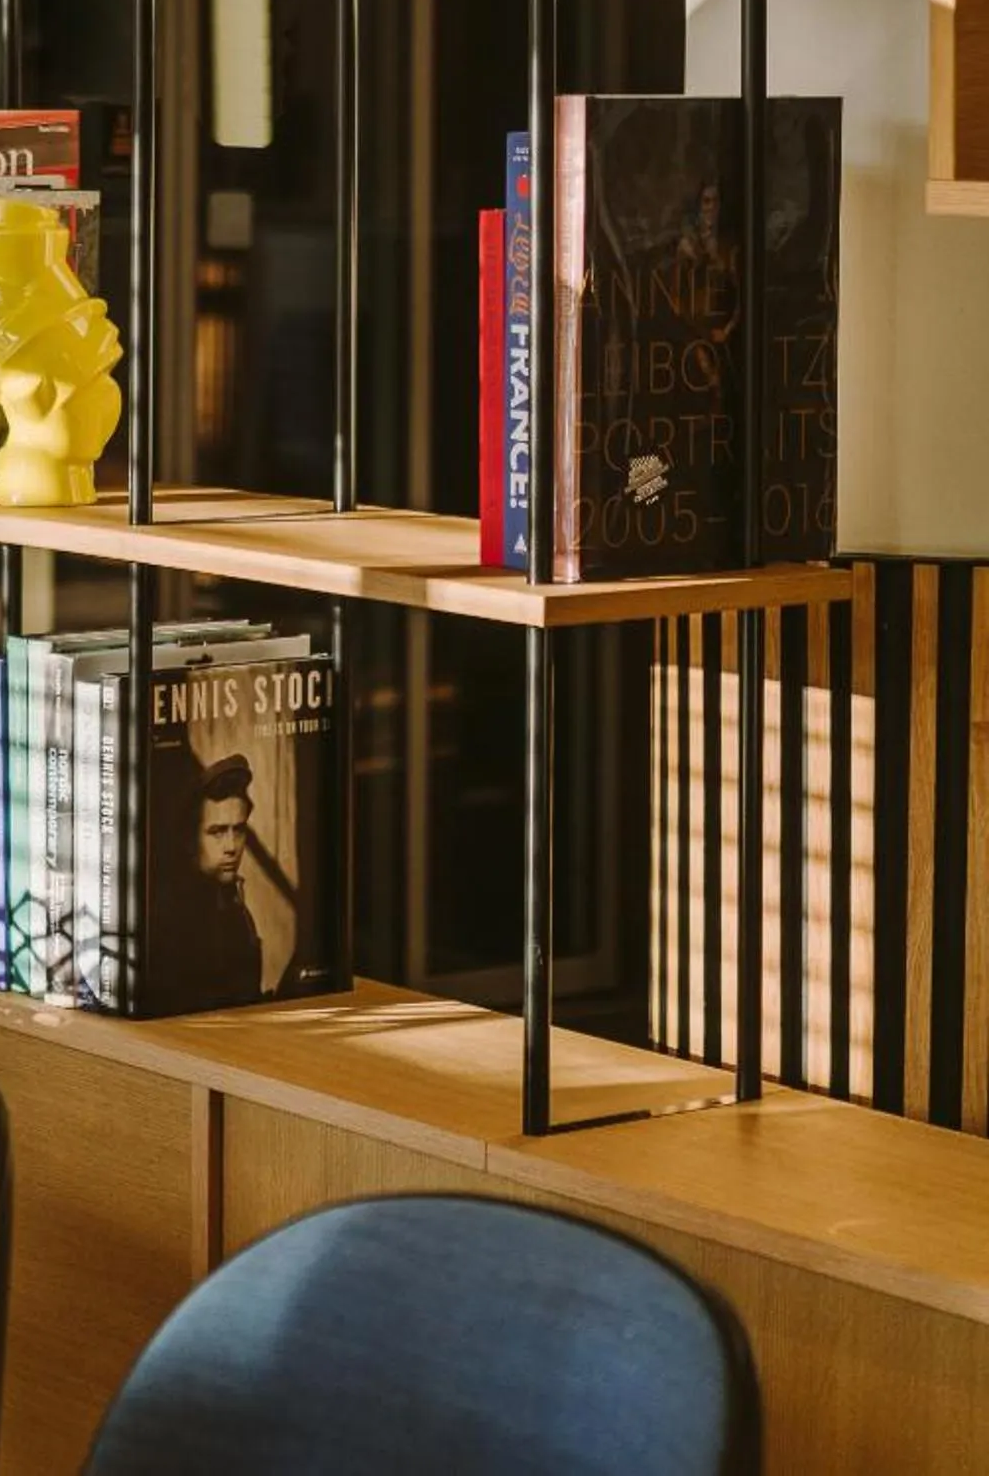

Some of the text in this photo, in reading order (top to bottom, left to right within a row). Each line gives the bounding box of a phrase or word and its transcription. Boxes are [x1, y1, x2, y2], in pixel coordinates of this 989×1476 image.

[574, 408, 838, 474] PORTRITS
[153, 678, 240, 725] ENNIS
[58, 748, 69, 803] nordic
[102, 736, 114, 785] DENNIS
[46, 747, 58, 868] contemporary
[101, 790, 114, 835] STOCK
